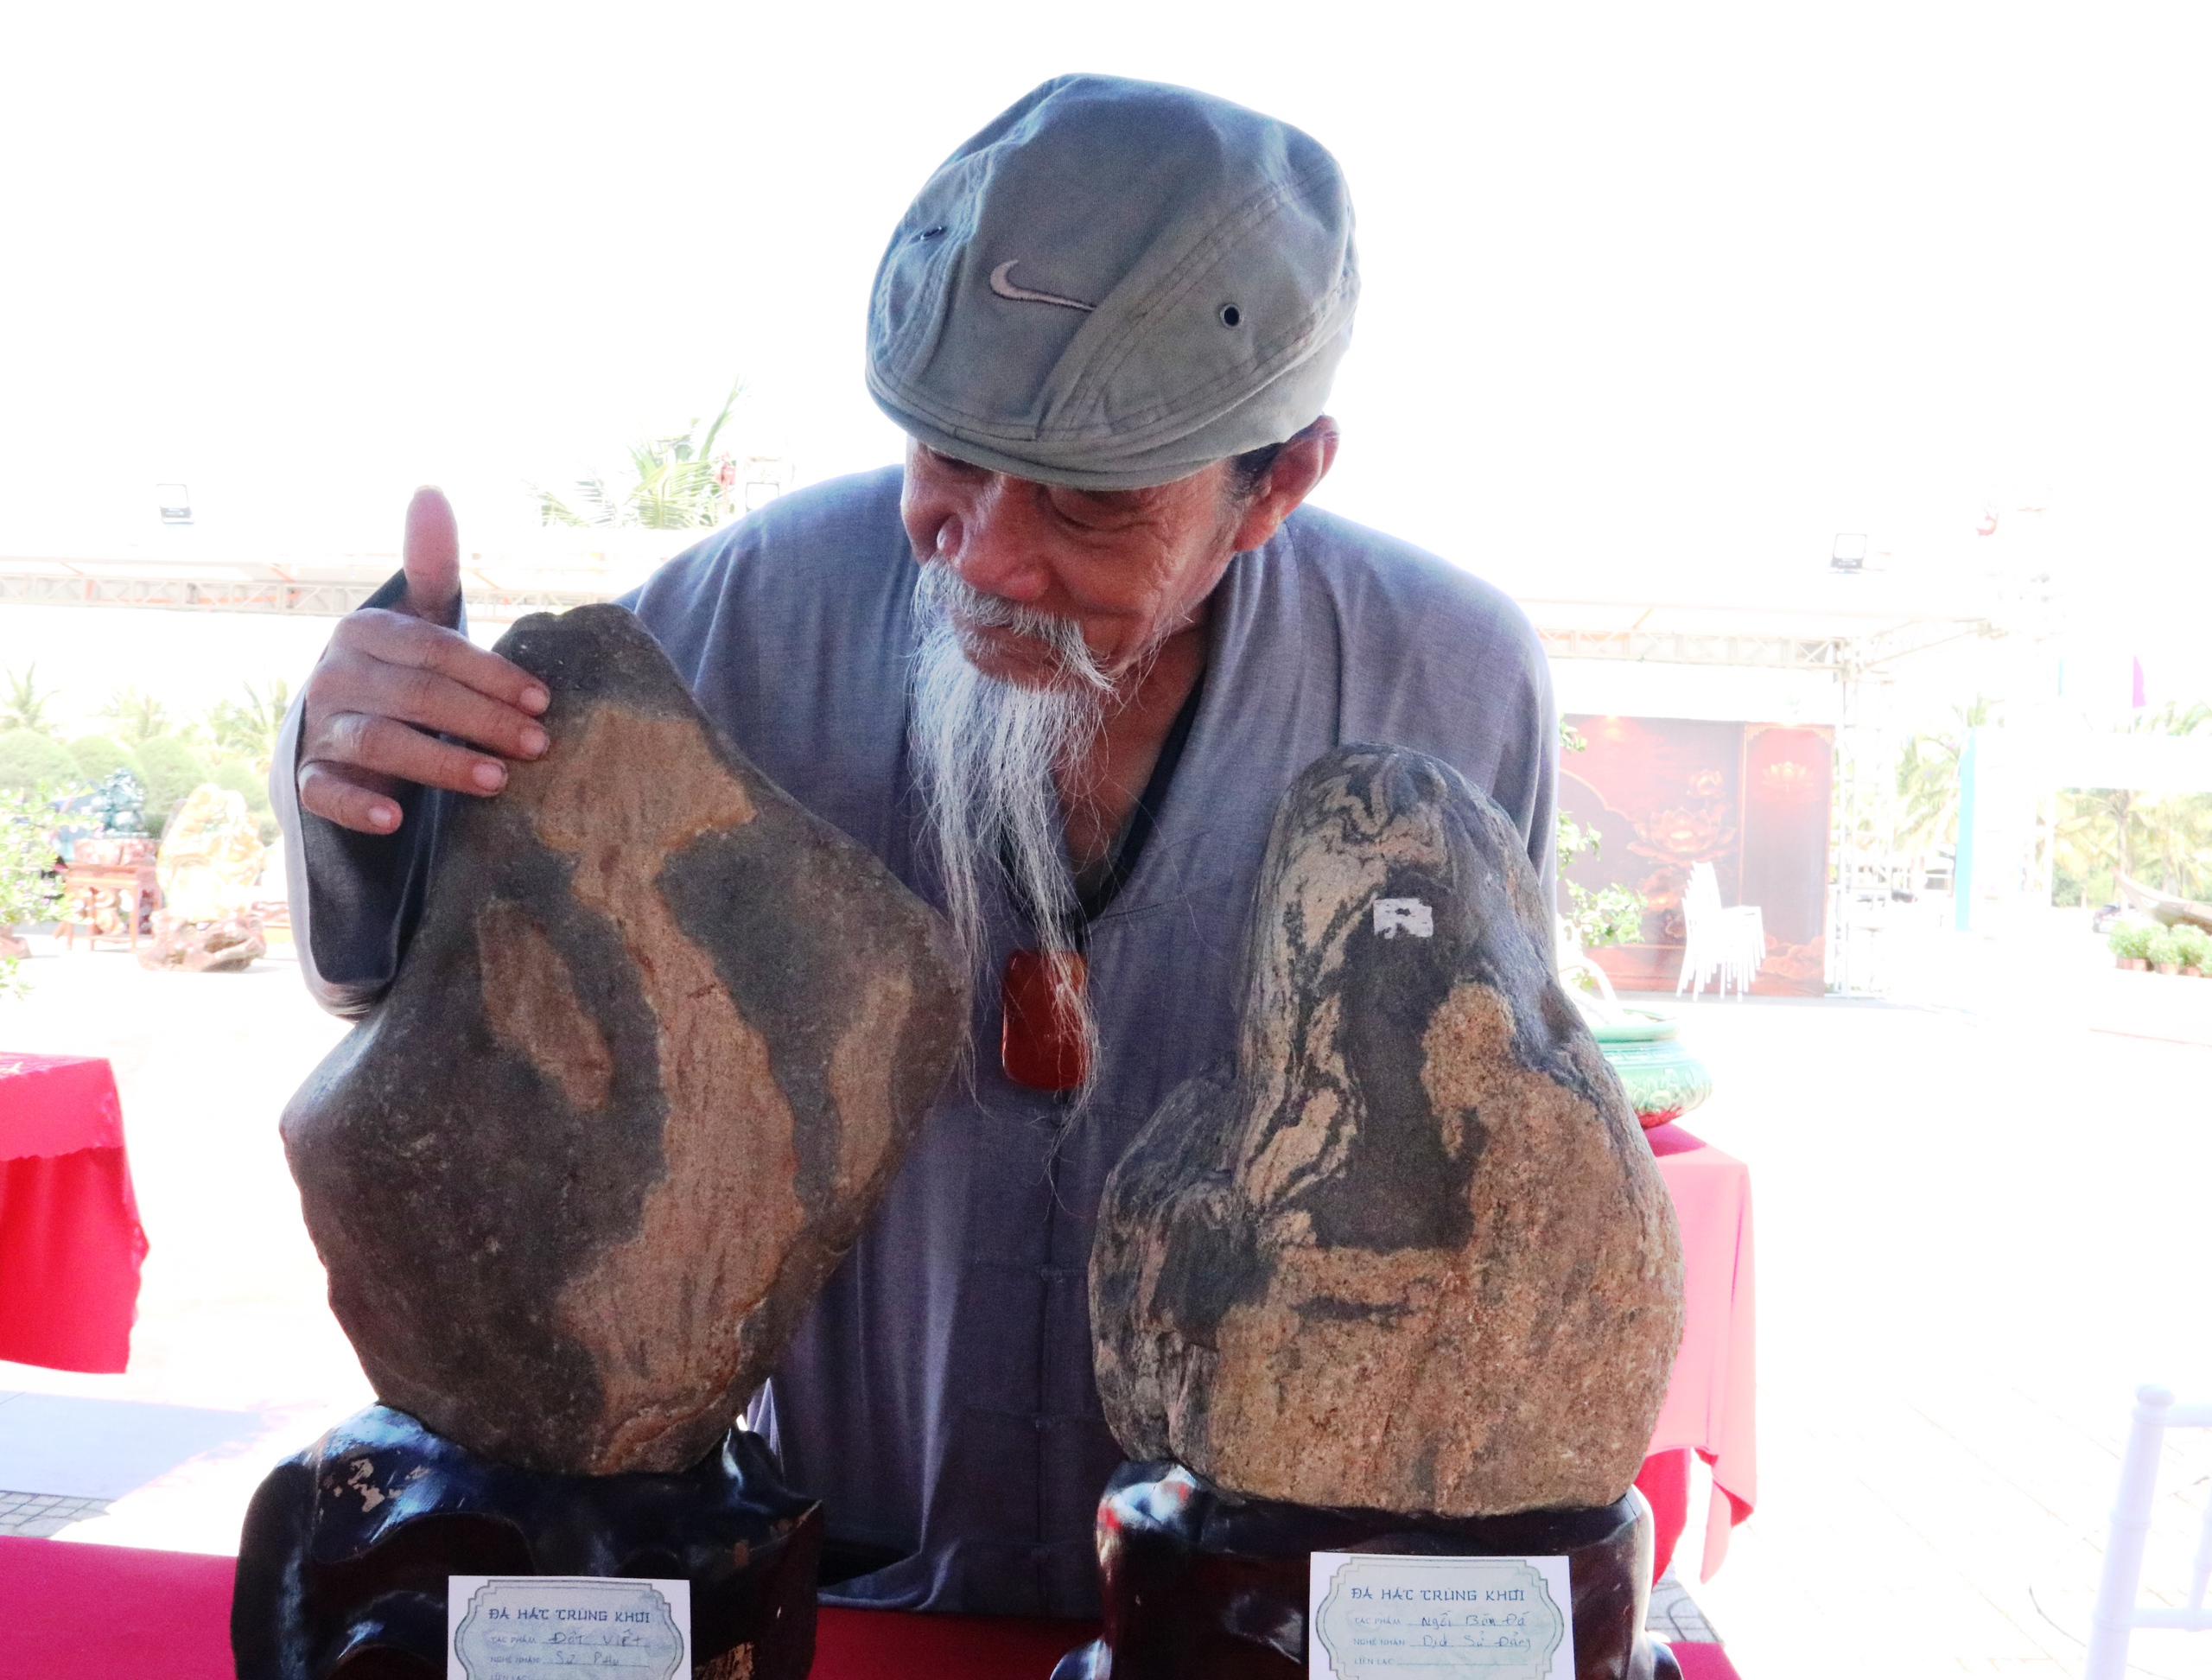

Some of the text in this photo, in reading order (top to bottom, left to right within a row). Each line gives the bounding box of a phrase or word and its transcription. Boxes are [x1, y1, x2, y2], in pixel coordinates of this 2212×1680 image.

[1351, 1587, 1373, 1599] ĐÁ
[1381, 1587, 1414, 1600] HÁT
[488, 1607, 510, 1620] ĐÁ
[517, 1607, 550, 1620] HÁT
